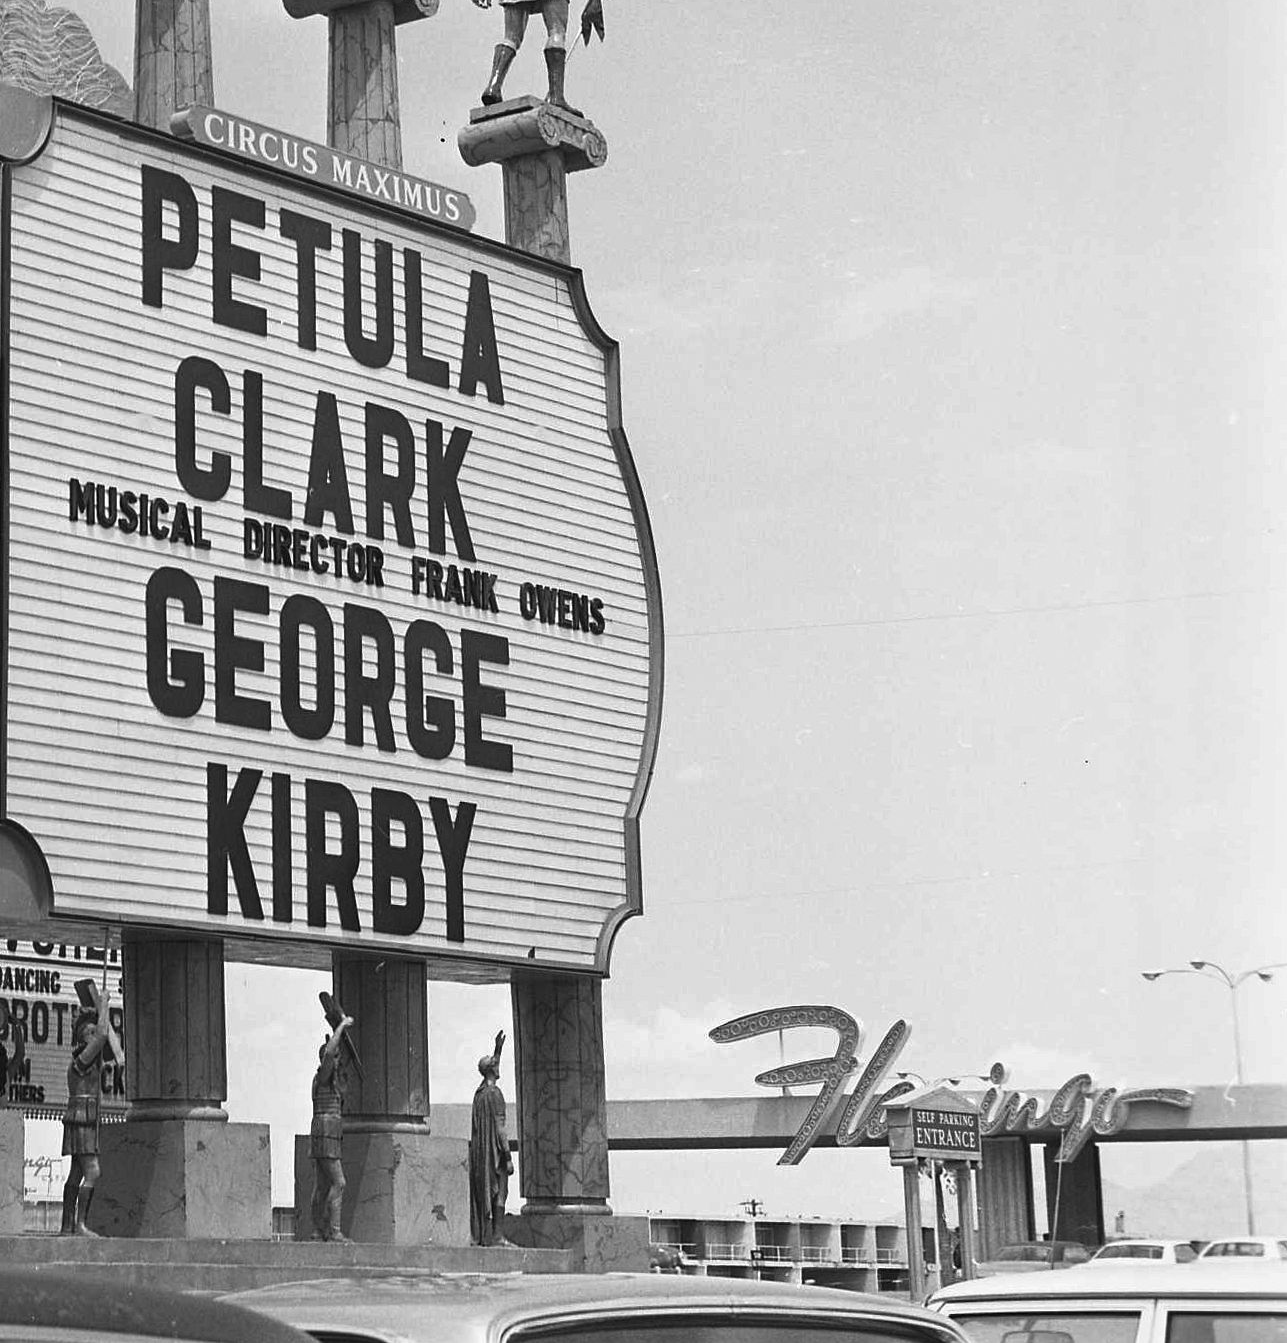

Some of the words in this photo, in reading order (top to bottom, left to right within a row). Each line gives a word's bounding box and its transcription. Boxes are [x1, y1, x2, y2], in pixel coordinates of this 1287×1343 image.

[203, 113, 319, 174] CIRCUS
[331, 154, 461, 221] MAXIMUS
[141, 163, 504, 406] PETULA
[175, 355, 476, 562] CLARK
[69, 478, 212, 550] MUSICAL
[243, 517, 385, 587] DIRECTOR
[412, 556, 499, 613] FRANK
[519, 581, 606, 635] OWENS
[146, 566, 513, 773] GEORGE
[207, 762, 477, 943] KIRBY
[916, 1111, 936, 1124] SELF
[938, 1113, 974, 1127] PARKING
[916, 1127, 976, 1148] ENTRANCE
